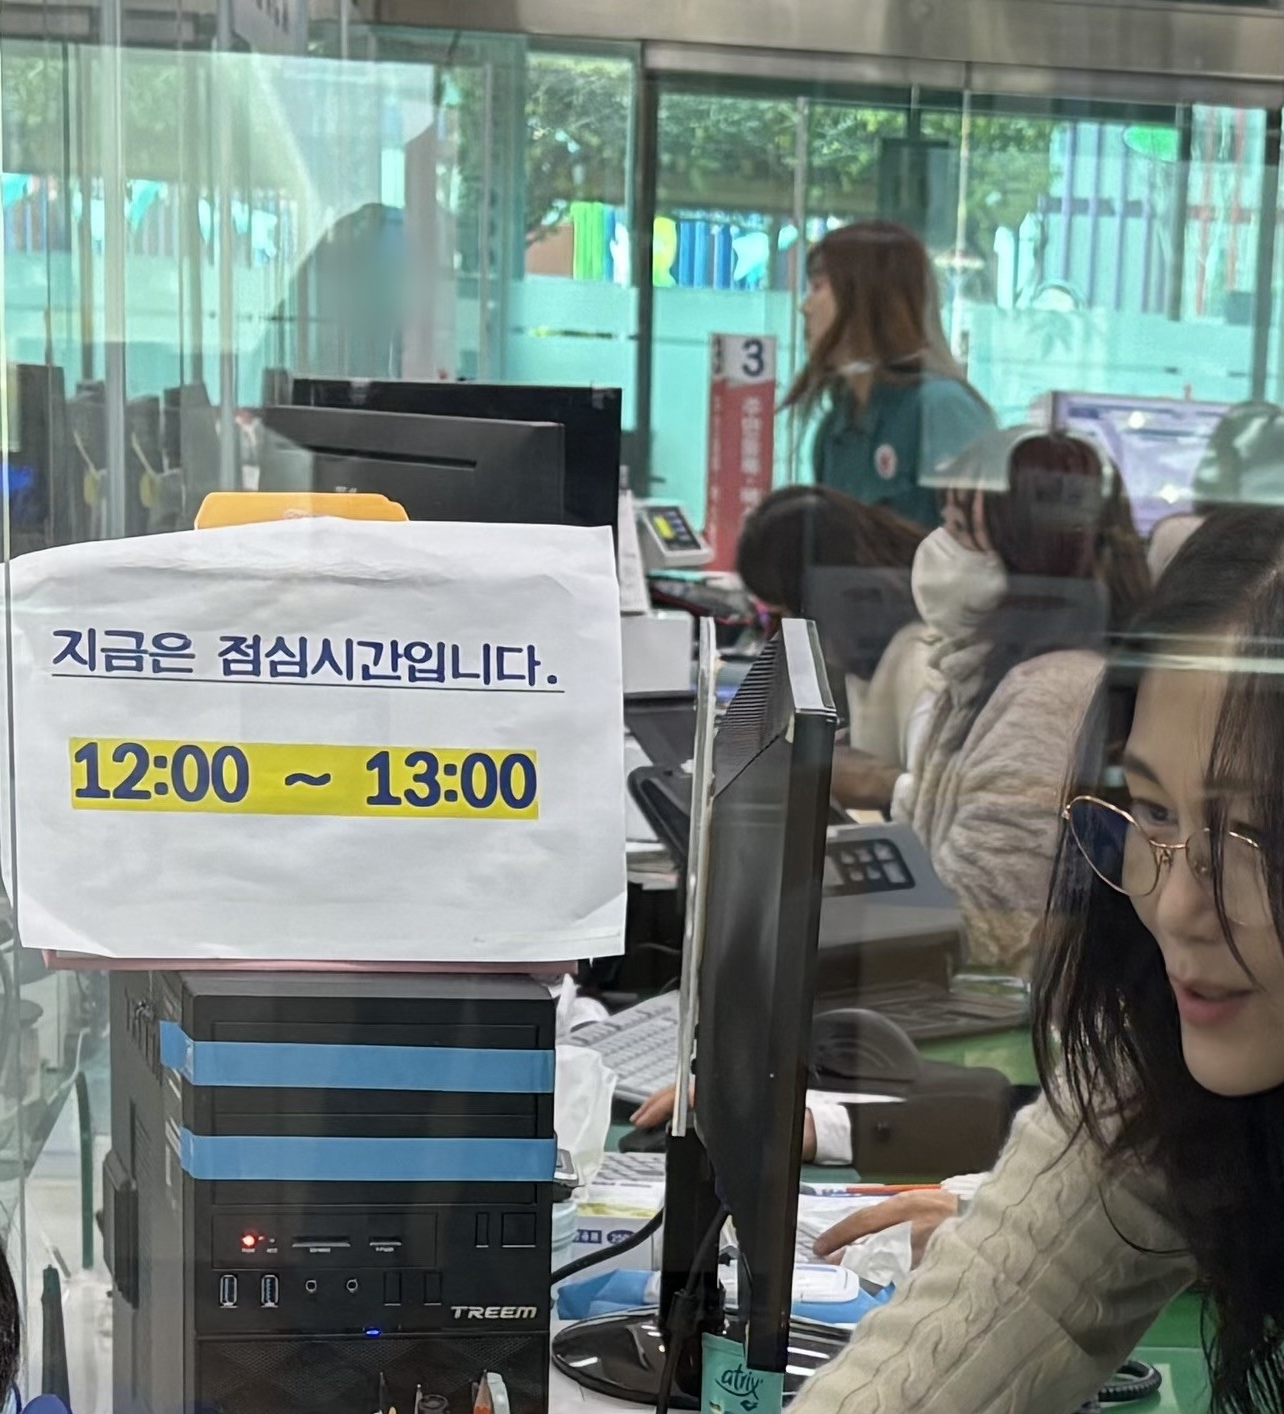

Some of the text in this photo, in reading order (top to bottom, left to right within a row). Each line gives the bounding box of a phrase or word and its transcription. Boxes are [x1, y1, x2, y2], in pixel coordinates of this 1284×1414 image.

[741, 338, 765, 378] 3
[53, 628, 558, 685] 지금은 점심시간입니다.
[74, 742, 537, 810] 12:00 ~ 13:00
[450, 1306, 537, 1319] TREEM
[720, 1363, 760, 1400] atrix
